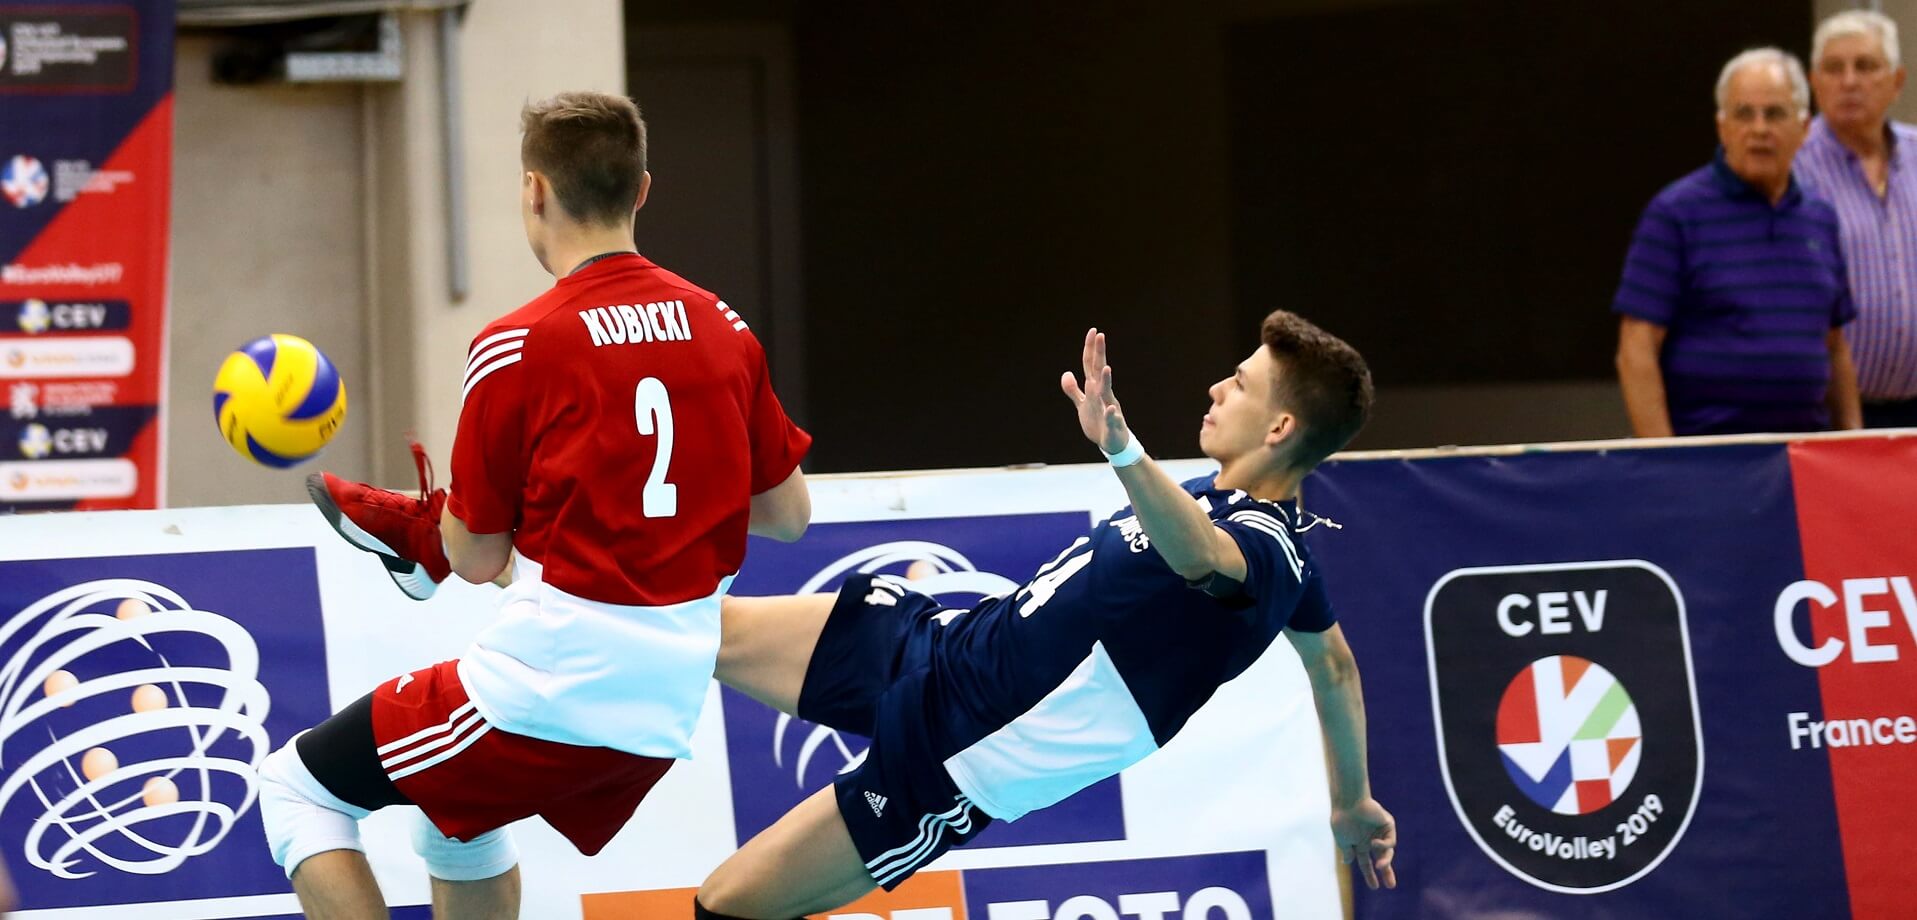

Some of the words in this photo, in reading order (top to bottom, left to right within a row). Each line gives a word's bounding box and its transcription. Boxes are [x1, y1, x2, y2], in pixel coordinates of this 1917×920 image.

[53, 304, 107, 328] CEV
[579, 300, 692, 347] KUBICKI
[54, 428, 108, 453] CEV
[635, 376, 677, 518] 2
[1497, 589, 1608, 637] CEV
[1787, 712, 1917, 750] France
[1493, 804, 1616, 860] EuroVolley
[1615, 793, 1664, 846] 2019
